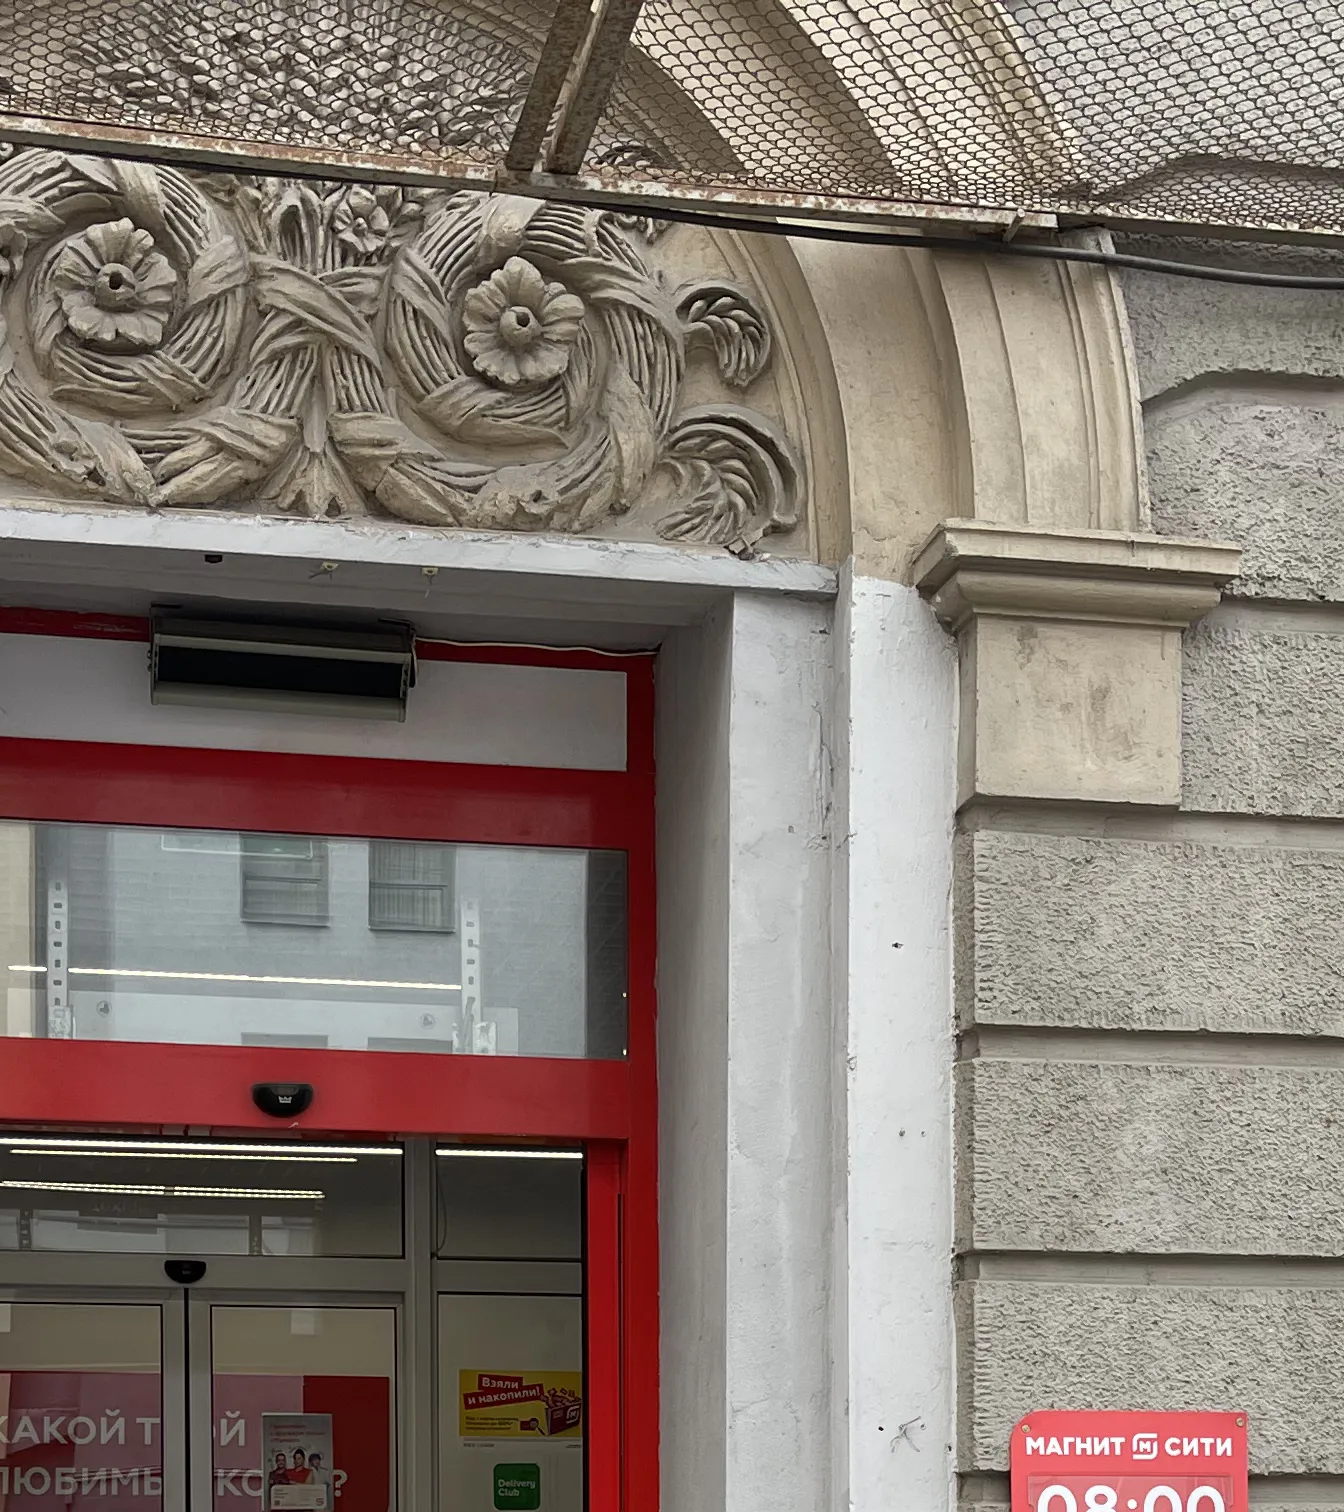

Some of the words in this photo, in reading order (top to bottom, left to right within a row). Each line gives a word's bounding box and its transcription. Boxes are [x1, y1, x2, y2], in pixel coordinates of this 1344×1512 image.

[482, 1377, 519, 1389] Взяли
[479, 1386, 541, 1403] накопили!
[136, 1410, 246, 1446] ТЙ
[1025, 1436, 1126, 1456] МАГНИТ
[1164, 1437, 1233, 1457] СИТИ
[497, 1479, 536, 1489] Delivery
[497, 1488, 520, 1497] Club
